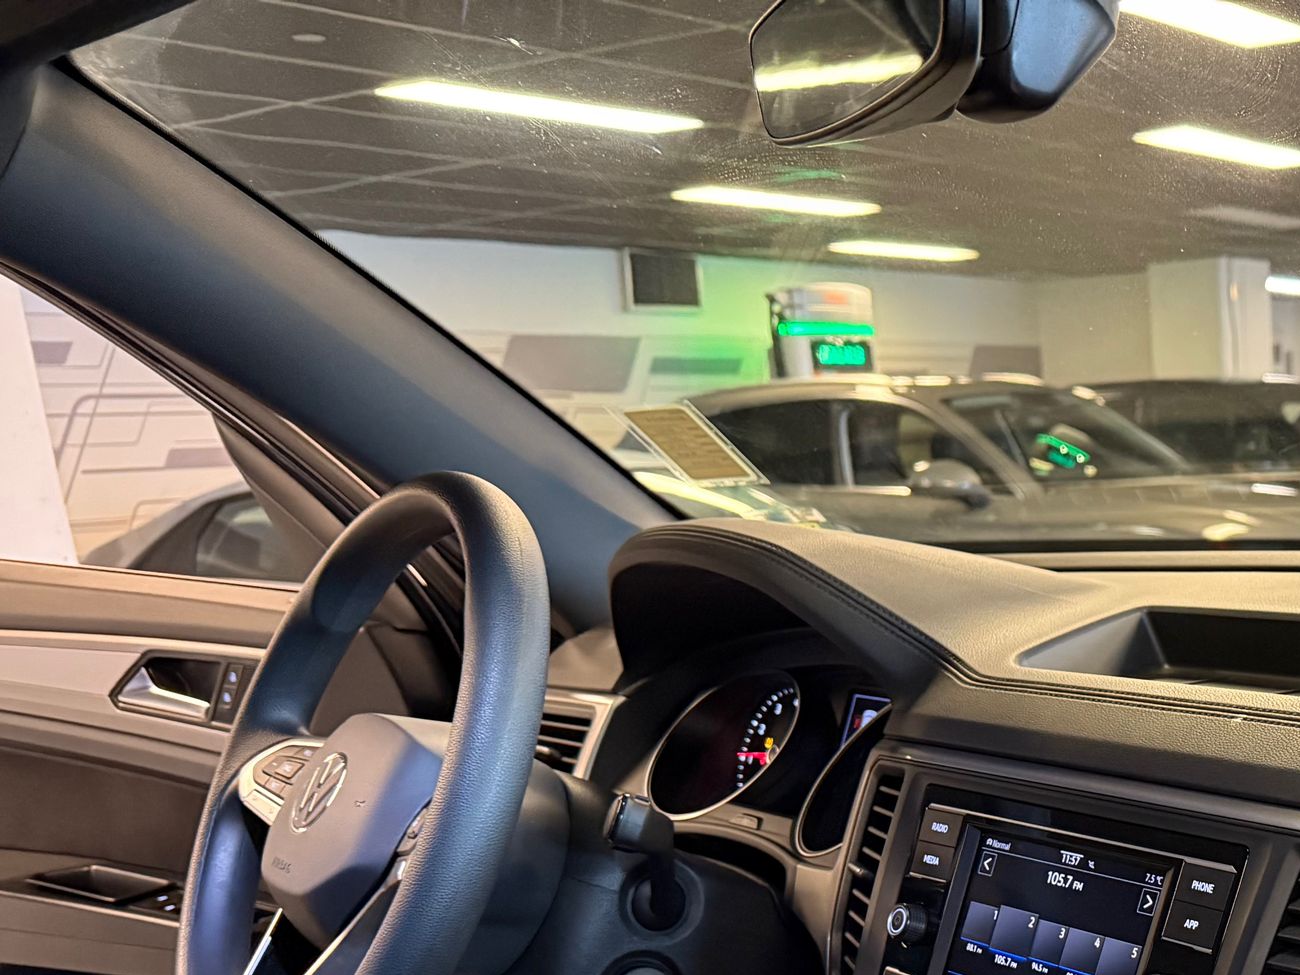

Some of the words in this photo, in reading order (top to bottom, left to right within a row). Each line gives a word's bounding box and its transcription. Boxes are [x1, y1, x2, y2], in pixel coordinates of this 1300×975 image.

[931, 821, 948, 833] RADIO
[992, 839, 1011, 851] Normal
[923, 854, 940, 866] MEDIA
[1047, 871, 1073, 888] 105.7
[1072, 880, 1084, 892] FM
[1145, 873, 1155, 884] 7.5
[1191, 879, 1215, 894] PHONE
[993, 910, 998, 921] 1
[1028, 916, 1036, 929] 2
[1183, 918, 1199, 930] APP
[1058, 927, 1066, 939] 3
[1094, 937, 1101, 949] 4
[1131, 947, 1139, 959] 5
[994, 954, 1011, 967] 105.7
